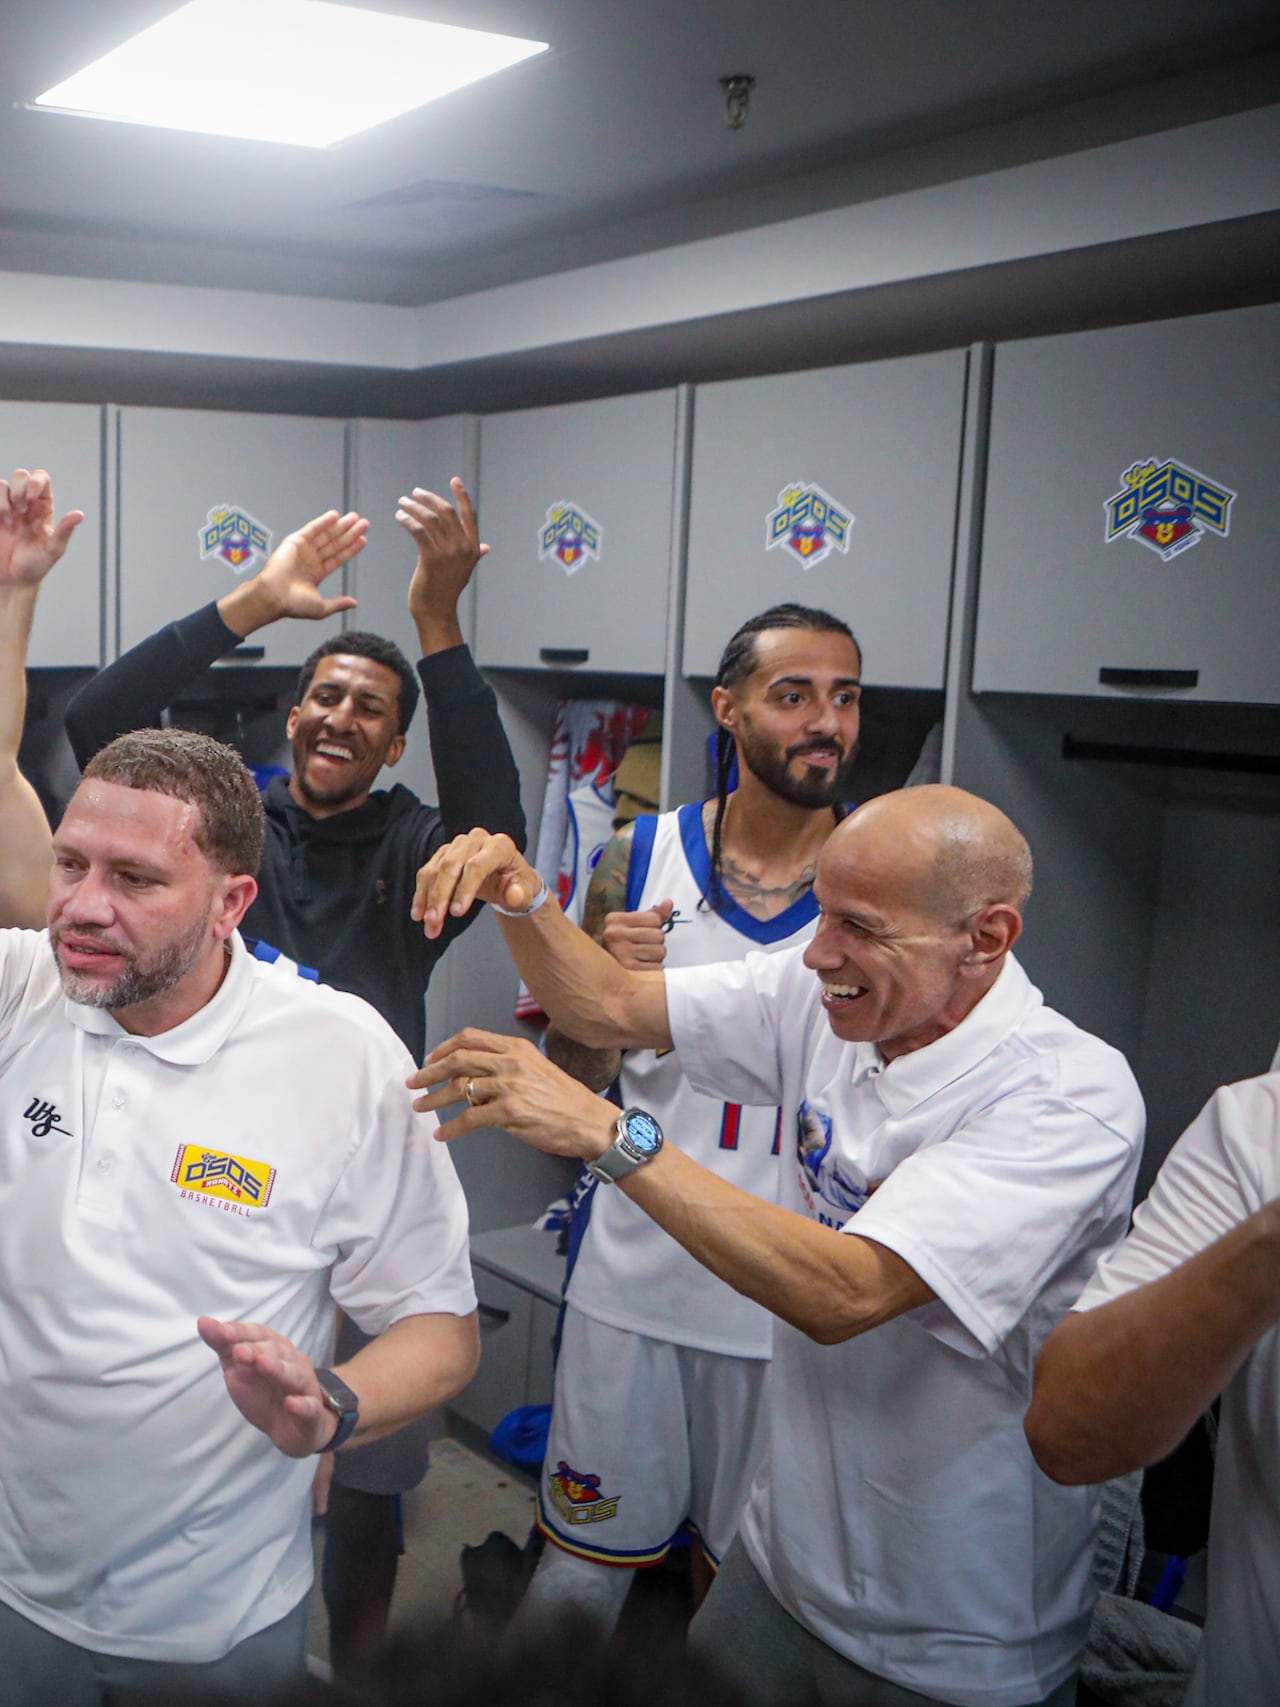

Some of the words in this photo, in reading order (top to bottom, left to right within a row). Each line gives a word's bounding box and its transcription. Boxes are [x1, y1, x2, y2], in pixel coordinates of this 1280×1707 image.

[1109, 464, 1231, 535] OSOS
[185, 1157, 263, 1201] OSOS
[180, 1189, 251, 1218] BASKETBALL
